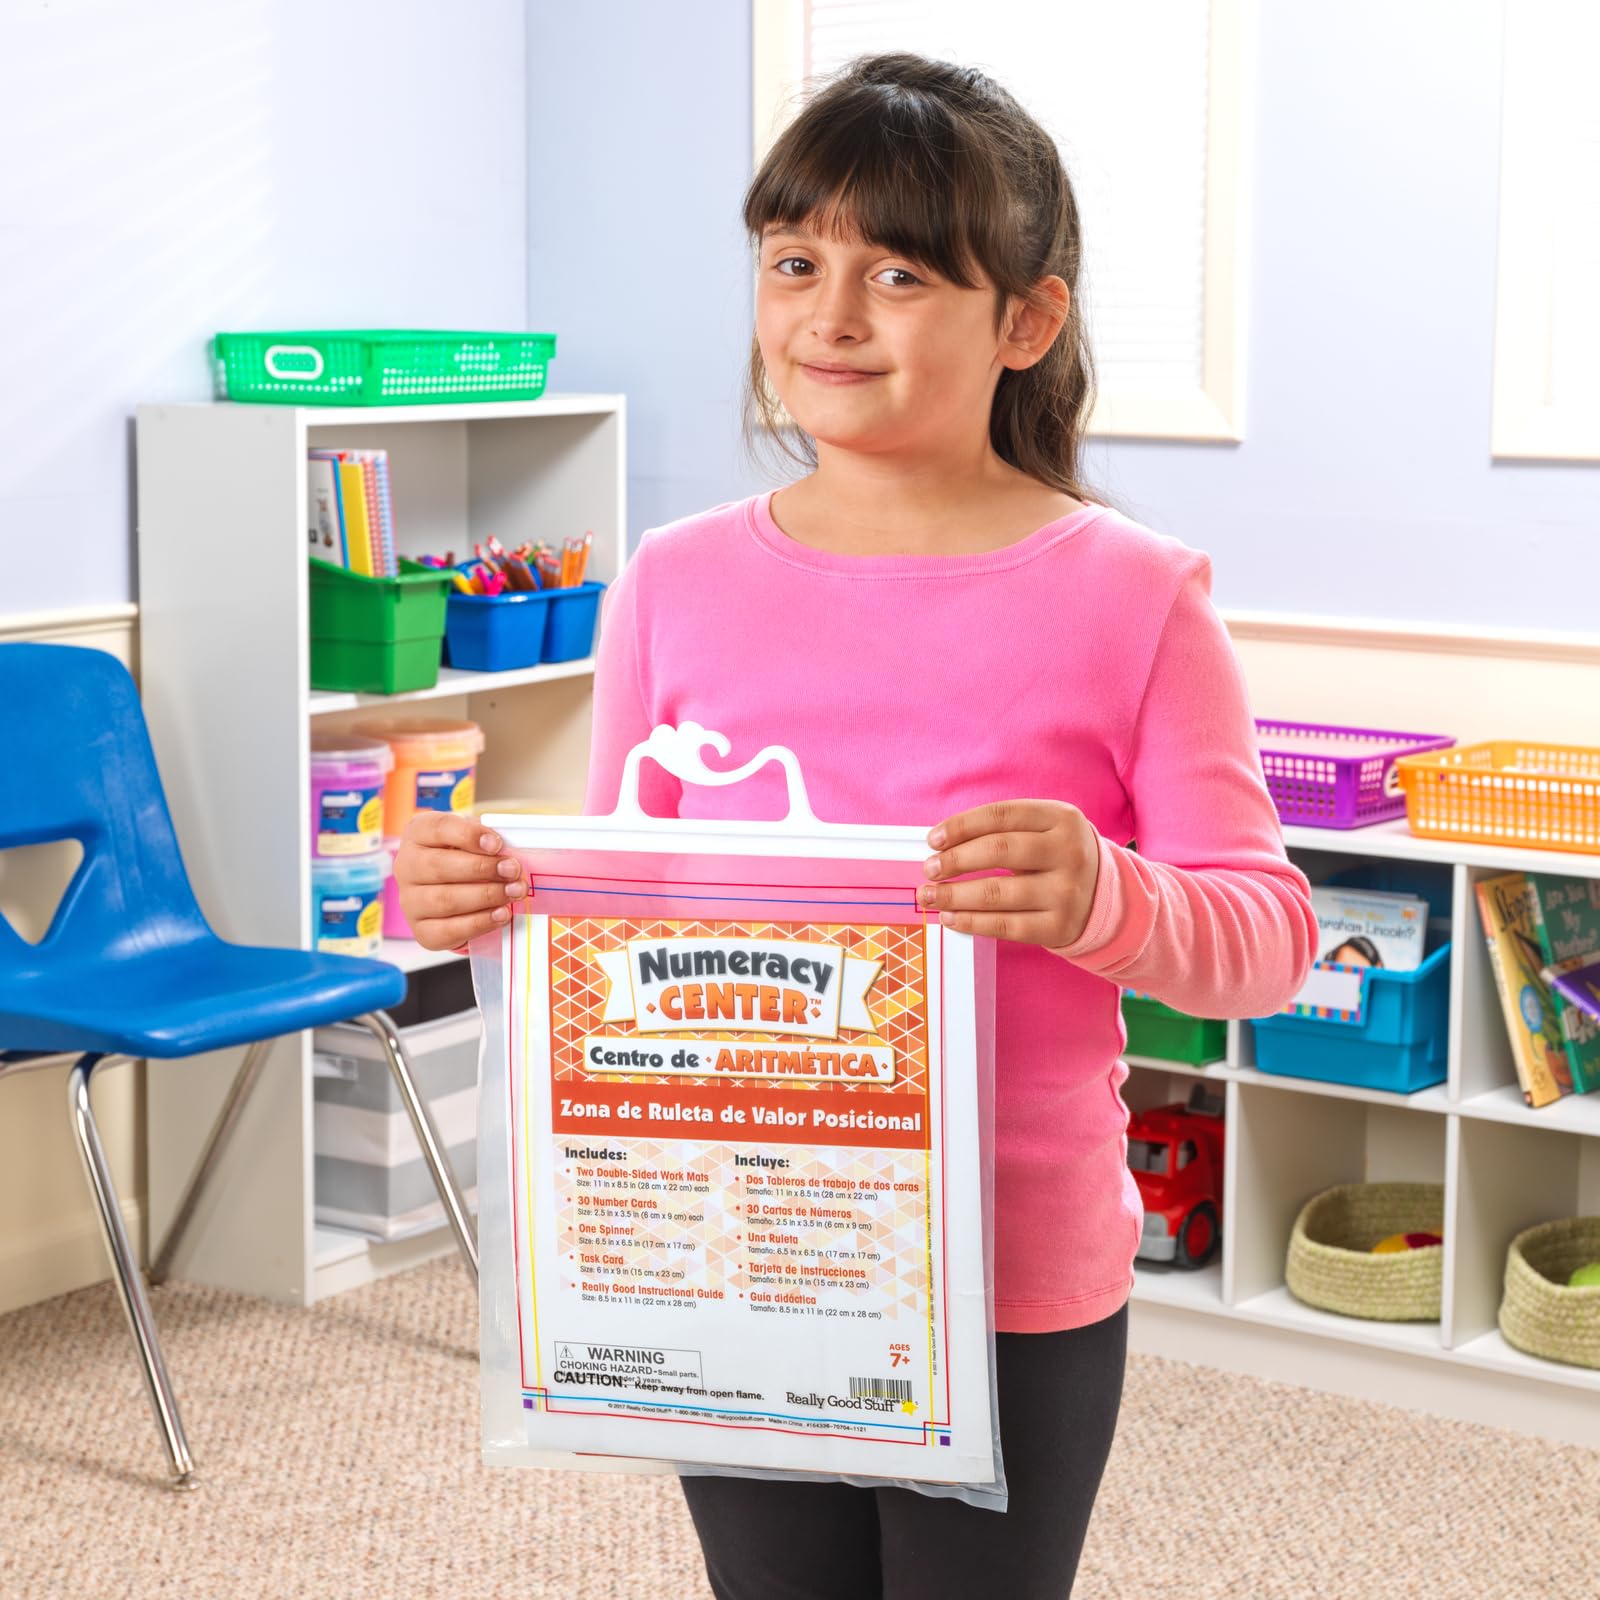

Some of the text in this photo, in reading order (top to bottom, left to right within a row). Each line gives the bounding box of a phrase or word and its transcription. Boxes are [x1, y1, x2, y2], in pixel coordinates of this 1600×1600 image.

[1318, 916, 1362, 932] braham
[638, 947, 834, 994] Numeracy
[590, 1046, 879, 1077] Centro de ARITMÉTICA
[560, 1099, 921, 1131] Zona de Ruleta de Valor Posicional
[565, 1147, 627, 1160] Includes:
[735, 1154, 789, 1170] Incluye:
[577, 1167, 709, 1182] Two Double-Sided Work Mats
[576, 1179, 591, 1187] Size:
[617, 1181, 628, 1189] 8.5
[638, 1182, 650, 1190] (28
[669, 1183, 678, 1191] 22
[679, 1184, 692, 1192] cm)
[746, 1174, 919, 1192] Dos Tableros de trabajo de dos caras
[776, 1188, 783, 1196] 11
[800, 1189, 811, 1197] 8.5
[821, 1190, 834, 1199] (28
[853, 1192, 863, 1200] 22
[864, 1193, 878, 1201] cm)
[578, 1196, 657, 1209] 30 Number Cards
[578, 1208, 592, 1216] Size:
[594, 1209, 605, 1217] 2.5
[620, 1210, 631, 1218] 3.5
[641, 1211, 649, 1220] (6
[674, 1214, 687, 1222] cm)
[747, 1204, 852, 1219] 30 Cartas de Números
[579, 1224, 634, 1236] One Spinner
[776, 1218, 788, 1226] 2.5
[824, 1221, 832, 1229] (6
[858, 1223, 872, 1232] cm)
[579, 1237, 594, 1245] Size:
[621, 1239, 633, 1247] 6.5
[642, 1240, 654, 1248] (17
[682, 1243, 696, 1251] cm)
[748, 1232, 798, 1244] Una Ruleta
[580, 1253, 624, 1265] Task Card
[804, 1249, 815, 1257] 6.5
[825, 1250, 837, 1259] (17
[867, 1253, 881, 1261] cm)
[597, 1266, 601, 1274] 6
[616, 1267, 621, 1275] 9
[630, 1268, 642, 1276] (15
[661, 1270, 670, 1278] 23
[672, 1270, 685, 1279] cm)
[749, 1262, 782, 1275] Tarjeta
[785, 1264, 797, 1275] de
[582, 1282, 724, 1299] Really Good Instructional Guide
[813, 1278, 825, 1287] (15
[845, 1280, 854, 1288] 23
[856, 1281, 870, 1290] cm)
[624, 1296, 632, 1304] 11
[642, 1298, 654, 1306] (22
[673, 1299, 682, 1307] 28
[683, 1301, 697, 1309] cm)
[750, 1292, 816, 1305] Guía didáctica
[825, 1308, 837, 1317] (22
[857, 1310, 866, 1318] 28
[868, 1312, 882, 1320] cm)
[889, 1343, 910, 1352] AGES
[587, 1346, 665, 1365] WARNING
[890, 1352, 910, 1367] 7+
[560, 1360, 607, 1372] CHOKING
[679, 1370, 699, 1379] parts.
[553, 1370, 628, 1389] CAUTION:
[635, 1381, 658, 1392] Keep
[660, 1384, 684, 1395] away
[686, 1385, 707, 1396] from
[710, 1389, 733, 1399] open
[736, 1390, 765, 1401] flame.
[786, 1391, 825, 1409] Really
[827, 1395, 862, 1410] Good
